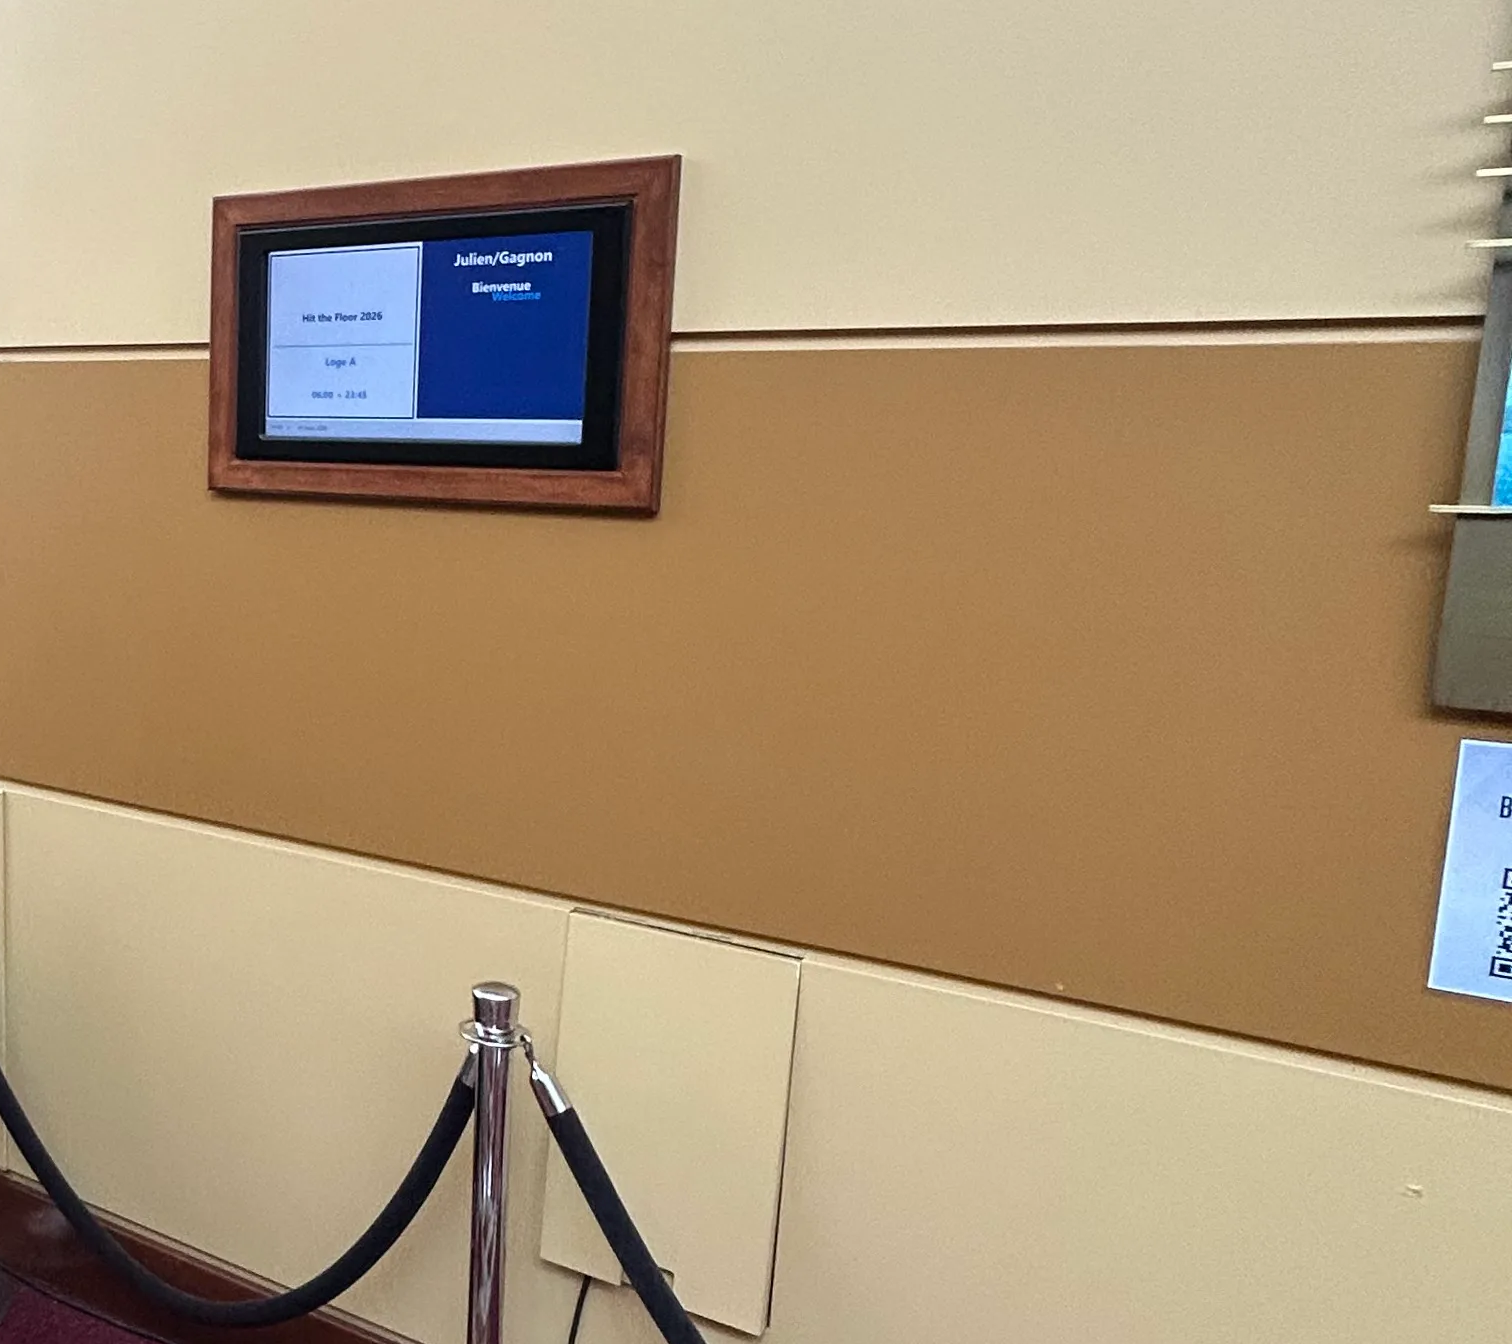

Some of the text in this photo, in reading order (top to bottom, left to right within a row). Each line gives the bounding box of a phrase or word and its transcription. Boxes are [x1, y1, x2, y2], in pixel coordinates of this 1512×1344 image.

[453, 251, 553, 267] Julien/Gagnon
[472, 281, 531, 293] Bienvenue
[492, 292, 541, 301] Welcome
[335, 312, 358, 322] Floor
[360, 311, 383, 321] 2026
[349, 357, 356, 366] A
